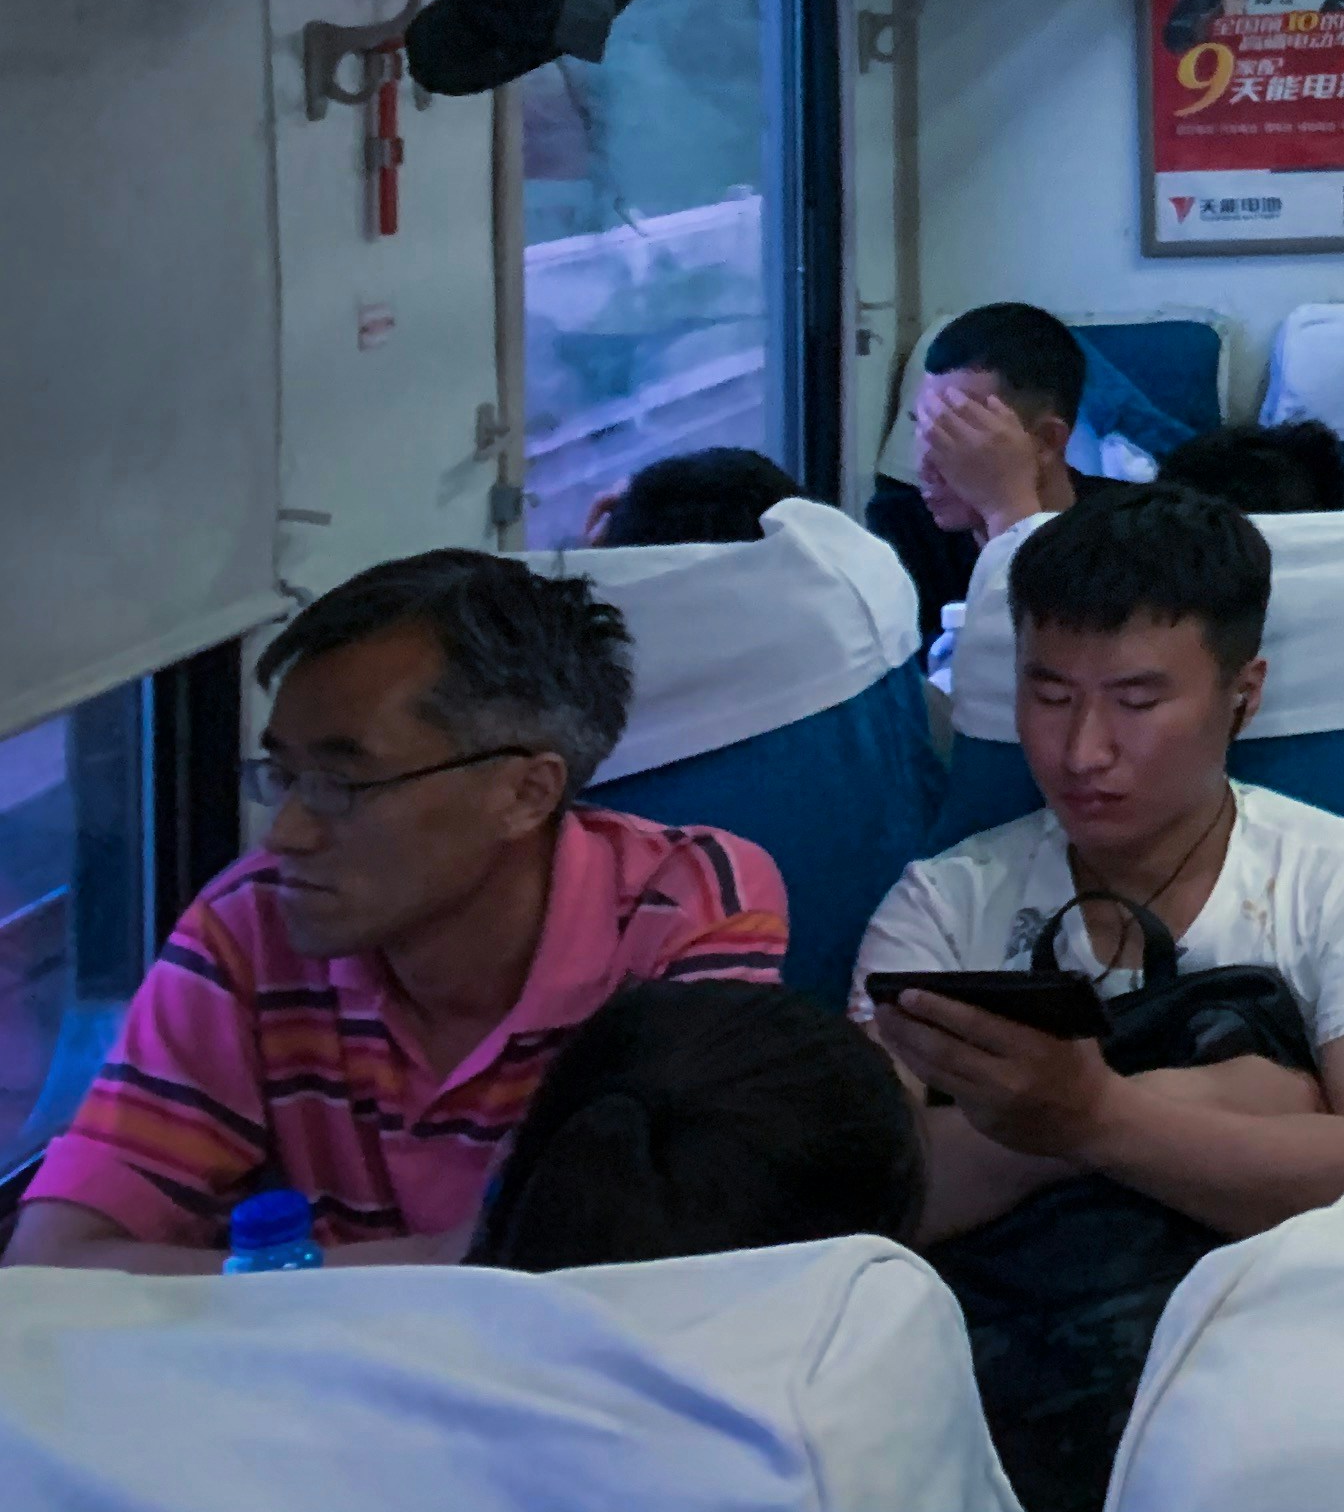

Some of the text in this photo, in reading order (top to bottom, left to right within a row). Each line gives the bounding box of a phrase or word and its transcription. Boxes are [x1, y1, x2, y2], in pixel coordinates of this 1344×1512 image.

[1173, 42, 1235, 118] 9
[1199, 197, 1282, 213] 天能电池
